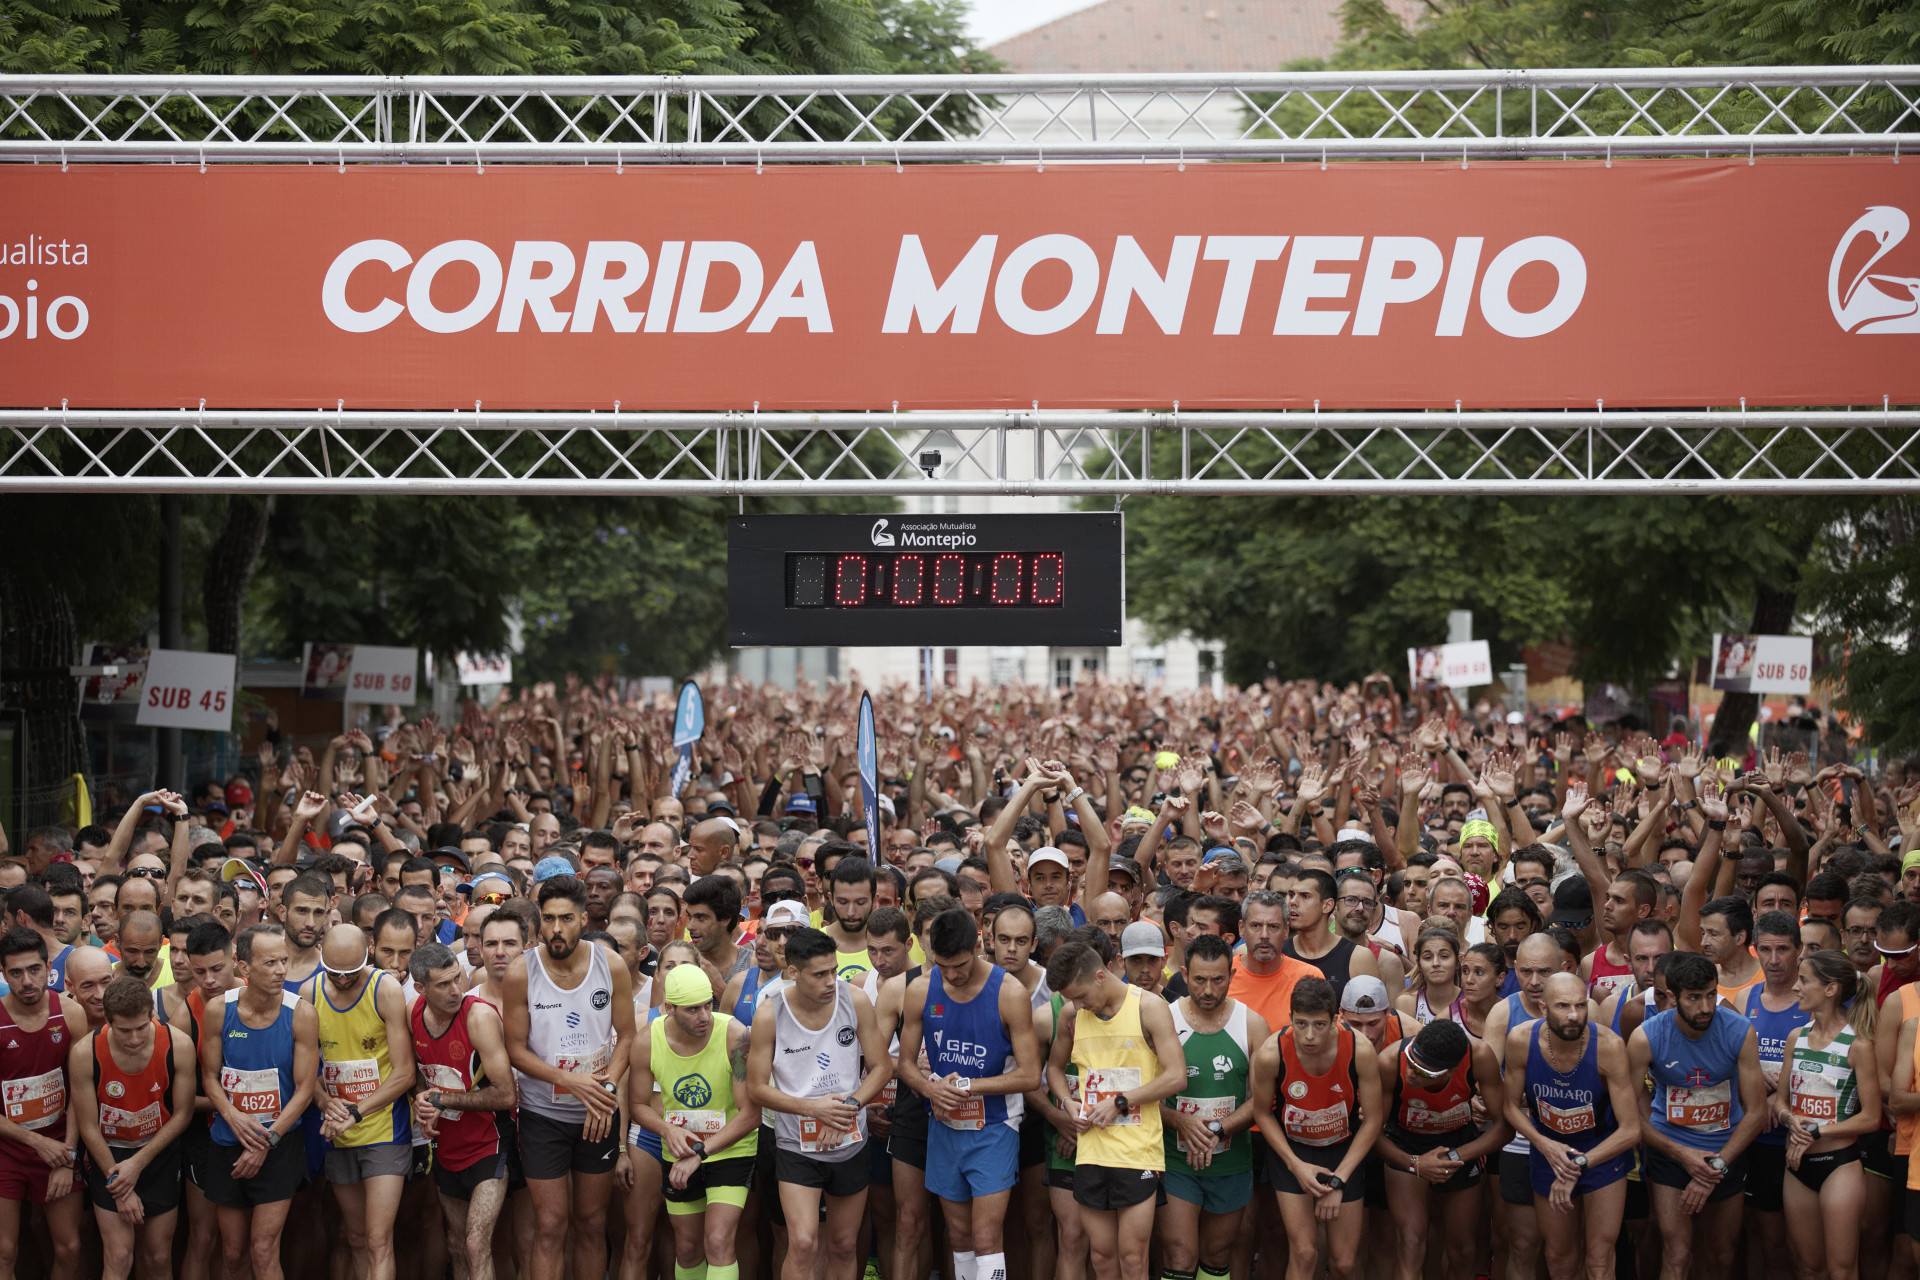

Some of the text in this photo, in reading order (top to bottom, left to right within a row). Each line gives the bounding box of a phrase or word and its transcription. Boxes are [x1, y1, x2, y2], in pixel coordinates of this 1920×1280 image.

[321, 233, 1588, 338] CORRIDA MONTEPIO
[900, 522, 976, 532] Associação Mutualista
[900, 531, 976, 549] Montepio
[1757, 663, 1807, 681] SUB 50
[353, 671, 412, 692] SUB 50
[148, 685, 227, 712] SUB 45
[946, 1039, 987, 1057] GFD
[938, 1052, 985, 1069] RUNNING
[354, 1067, 374, 1079] 4019
[42, 1079, 59, 1093] 2960
[345, 1081, 376, 1094] RICARDO
[811, 1078, 841, 1090] SANTO
[43, 1092, 62, 1106] HUGO
[241, 1093, 276, 1111] 4622
[1800, 1097, 1832, 1116] 4565
[1323, 1110, 1342, 1122] 3957
[1691, 1104, 1725, 1122] 4224
[705, 1120, 721, 1130] 258
[1306, 1119, 1344, 1133] LEONARDO
[1556, 1114, 1590, 1130] 4352
